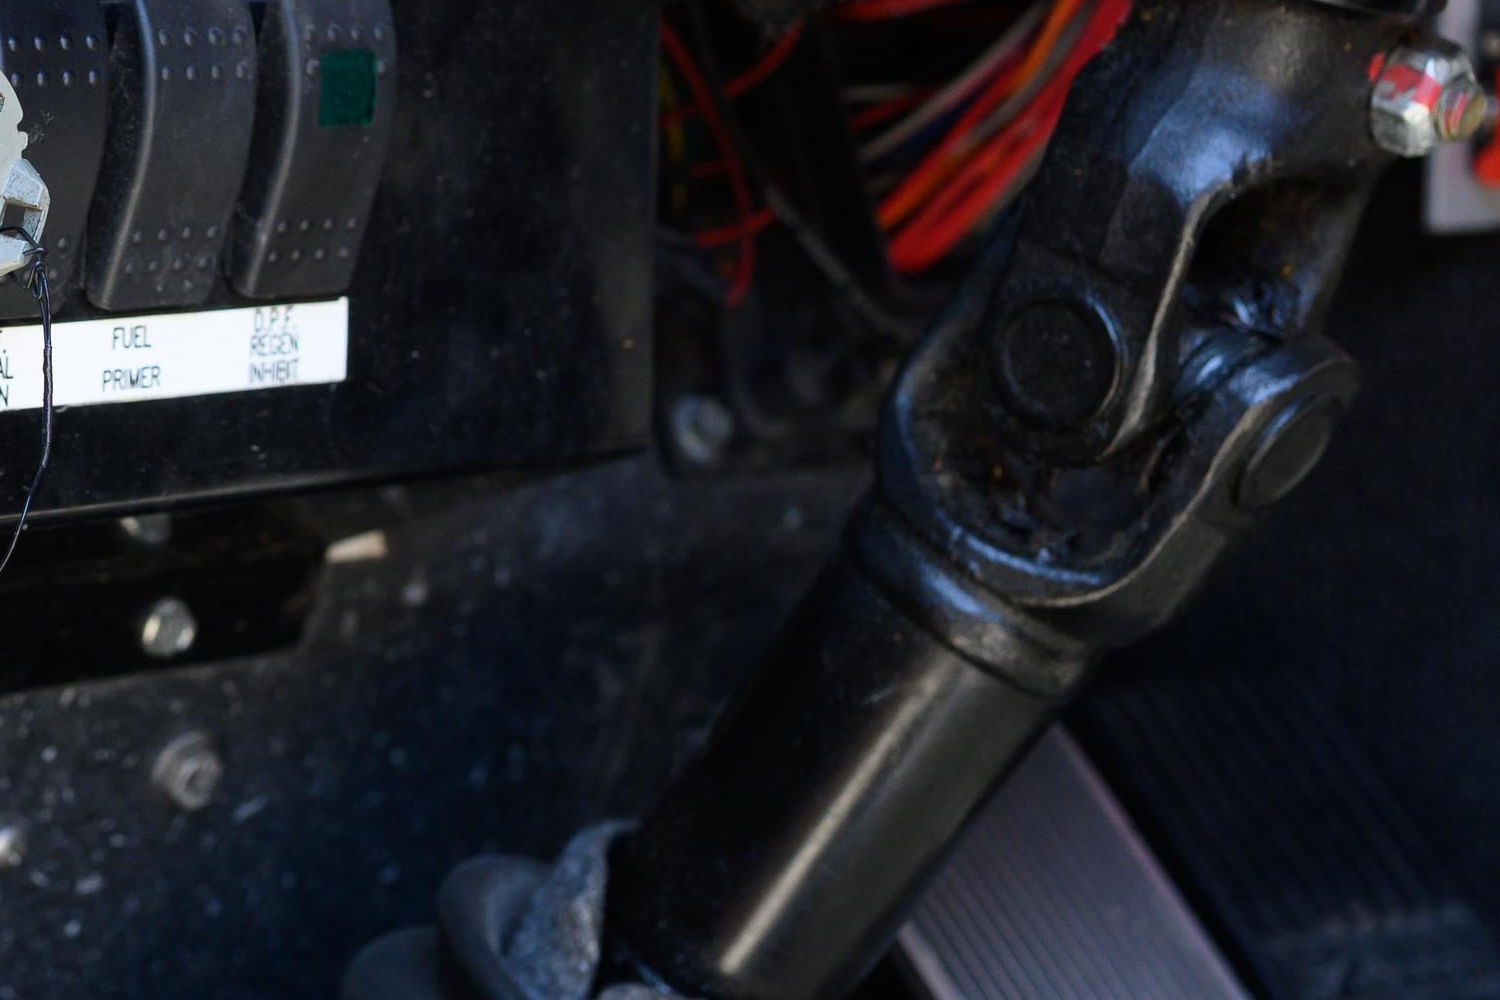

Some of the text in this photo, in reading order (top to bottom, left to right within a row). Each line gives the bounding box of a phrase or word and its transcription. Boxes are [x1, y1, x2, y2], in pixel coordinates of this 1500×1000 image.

[112, 325, 151, 350] FUEL
[250, 332, 298, 356] REGEN
[102, 365, 161, 392] PRIMER
